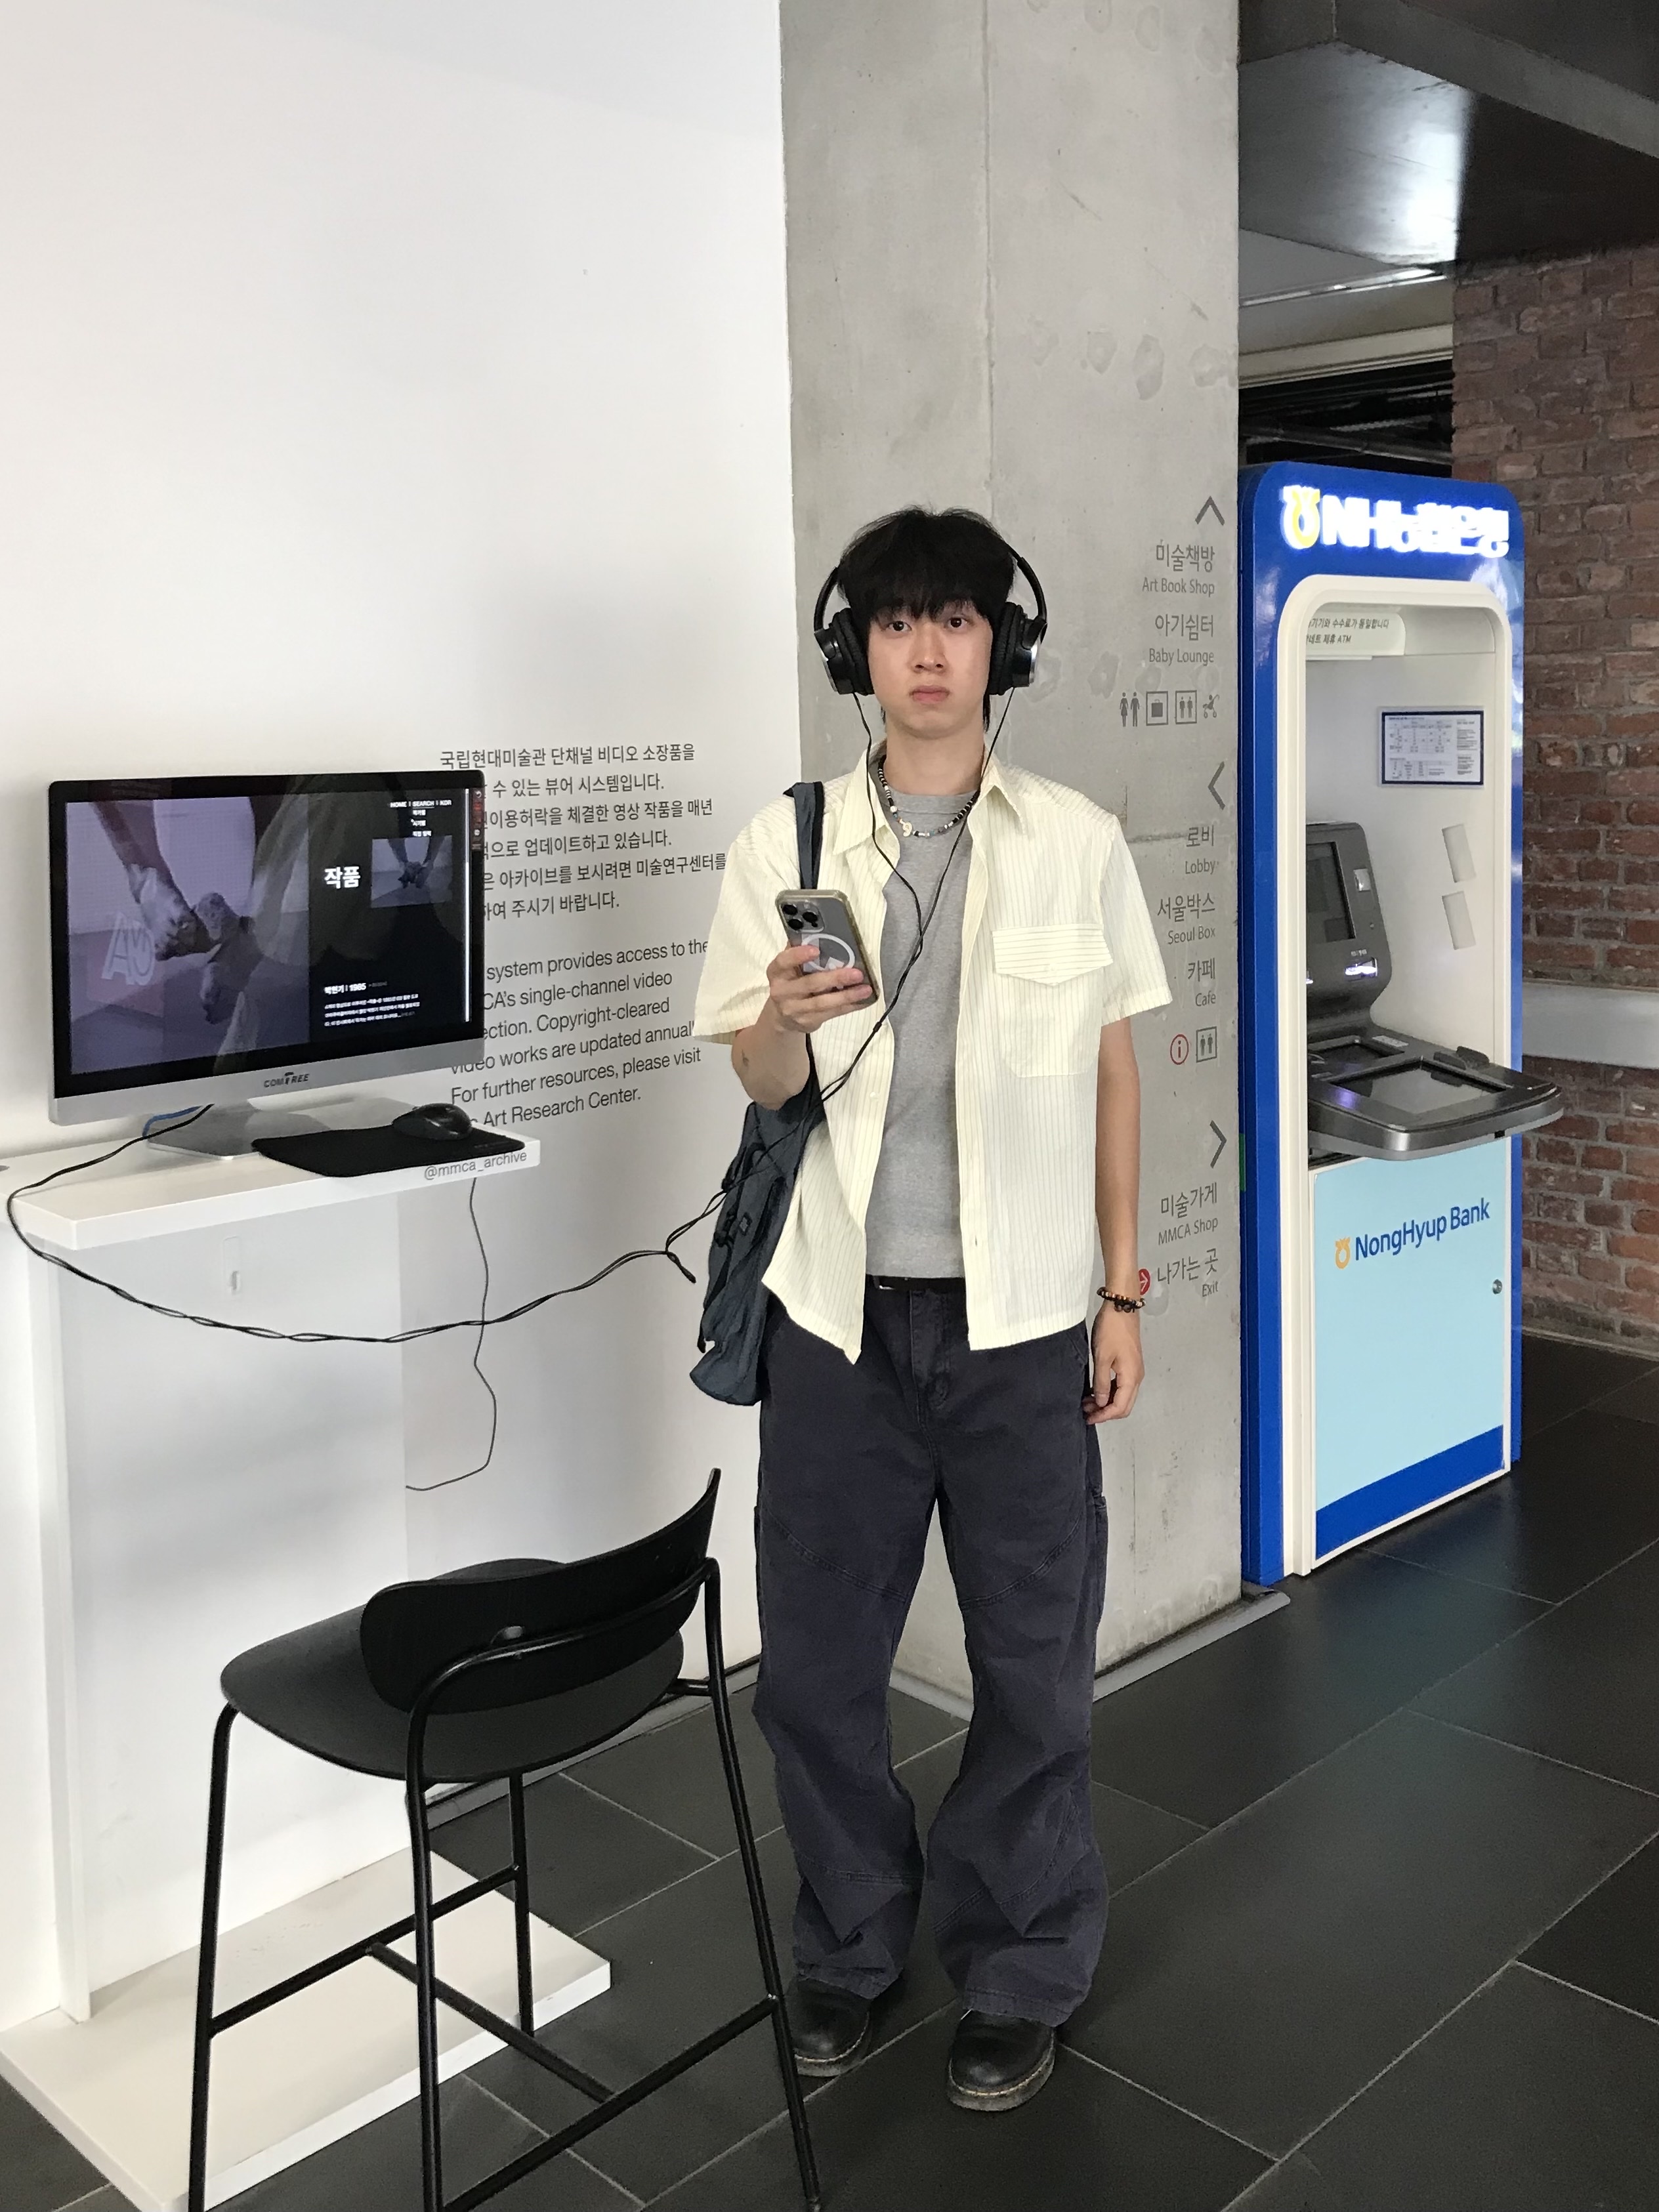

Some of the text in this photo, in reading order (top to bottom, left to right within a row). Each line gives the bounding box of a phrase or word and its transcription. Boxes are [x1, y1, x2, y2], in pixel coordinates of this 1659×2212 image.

[1156, 543, 1215, 573] 미술책방
[1142, 577, 1215, 597] Art Book Shop
[1155, 614, 1213, 641] 아기쉼터
[1337, 635, 1352, 644] ATM
[1149, 648, 1215, 667] Baby Lounge
[440, 743, 696, 770] 국립현대미술관 단채널 비디오 소장품을
[492, 780, 507, 799] 수
[512, 776, 541, 797] 있는
[545, 776, 573, 796] 뷰어
[578, 772, 664, 795] 시스템입니다.
[567, 804, 610, 824] 체결한
[614, 802, 640, 822] 영상
[644, 799, 684, 820] 작품을
[688, 797, 713, 817] 매년
[525, 834, 610, 857] 업데이트하고
[614, 829, 672, 850] 있습니다.
[1186, 825, 1215, 848] 로비
[324, 866, 361, 890] 작품
[499, 866, 572, 889] 아카이브를
[577, 858, 632, 883] 보시려면
[637, 852, 726, 881] 미술연구센터를
[1185, 858, 1216, 875] Lobby
[512, 896, 554, 919] 주시기
[559, 890, 620, 914] 바랍니다.
[1157, 892, 1215, 923] 서울박스
[1167, 925, 1215, 946] Seoul Box
[486, 959, 543, 984] system
[547, 950, 613, 976] provides
[616, 945, 667, 966] access
[671, 942, 685, 957] to
[1187, 957, 1215, 983] 카페
[520, 975, 631, 1007] single-channel
[633, 971, 673, 990] video
[1195, 990, 1216, 1007] Cafe
[536, 997, 670, 1032] Copyright-cleared
[499, 1045, 549, 1067] works
[552, 1041, 576, 1058] are
[580, 1028, 641, 1057] updated
[451, 1047, 702, 1106] For further resources, please visit
[484, 1086, 641, 1127] Art Research Center.
[424, 1151, 528, 1180] @mmca_archive
[1161, 1182, 1217, 1219] 미술가게
[1158, 1217, 1218, 1245] MMCA Shop
[1354, 1198, 1490, 1261] NongHyup Bank
[1157, 1247, 1218, 1285] 나가는 곳
[1202, 1280, 1219, 1297] Exit
